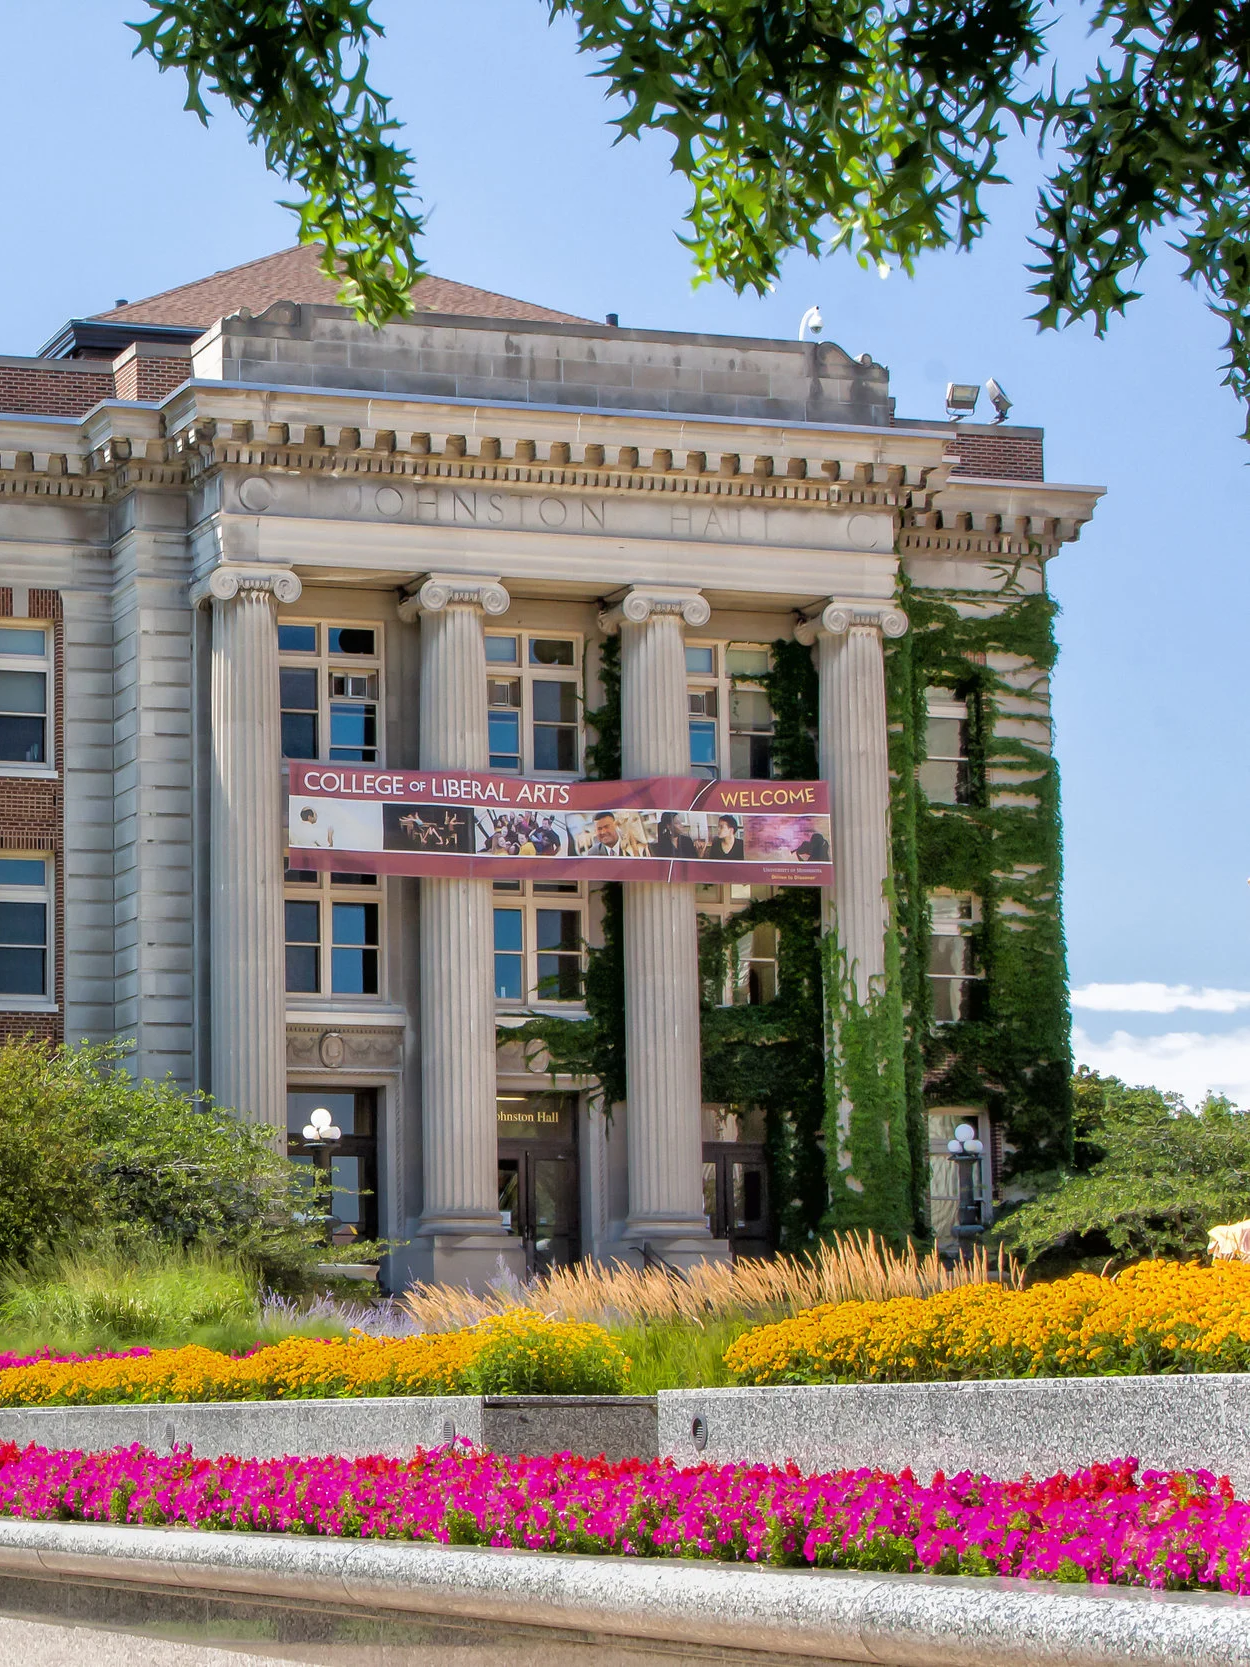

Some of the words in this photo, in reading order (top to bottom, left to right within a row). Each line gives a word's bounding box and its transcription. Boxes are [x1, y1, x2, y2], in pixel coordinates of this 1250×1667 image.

[341, 484, 606, 530] JOHNSTON
[670, 505, 783, 541] HALL
[303, 771, 405, 796] COLLEGE
[409, 781, 427, 792] OF
[431, 778, 511, 803] LIBERAL
[515, 783, 570, 805] ARTS
[720, 787, 816, 808] WELCOME
[496, 1111, 534, 1122] ohnston
[537, 1111, 559, 1123] Hall
